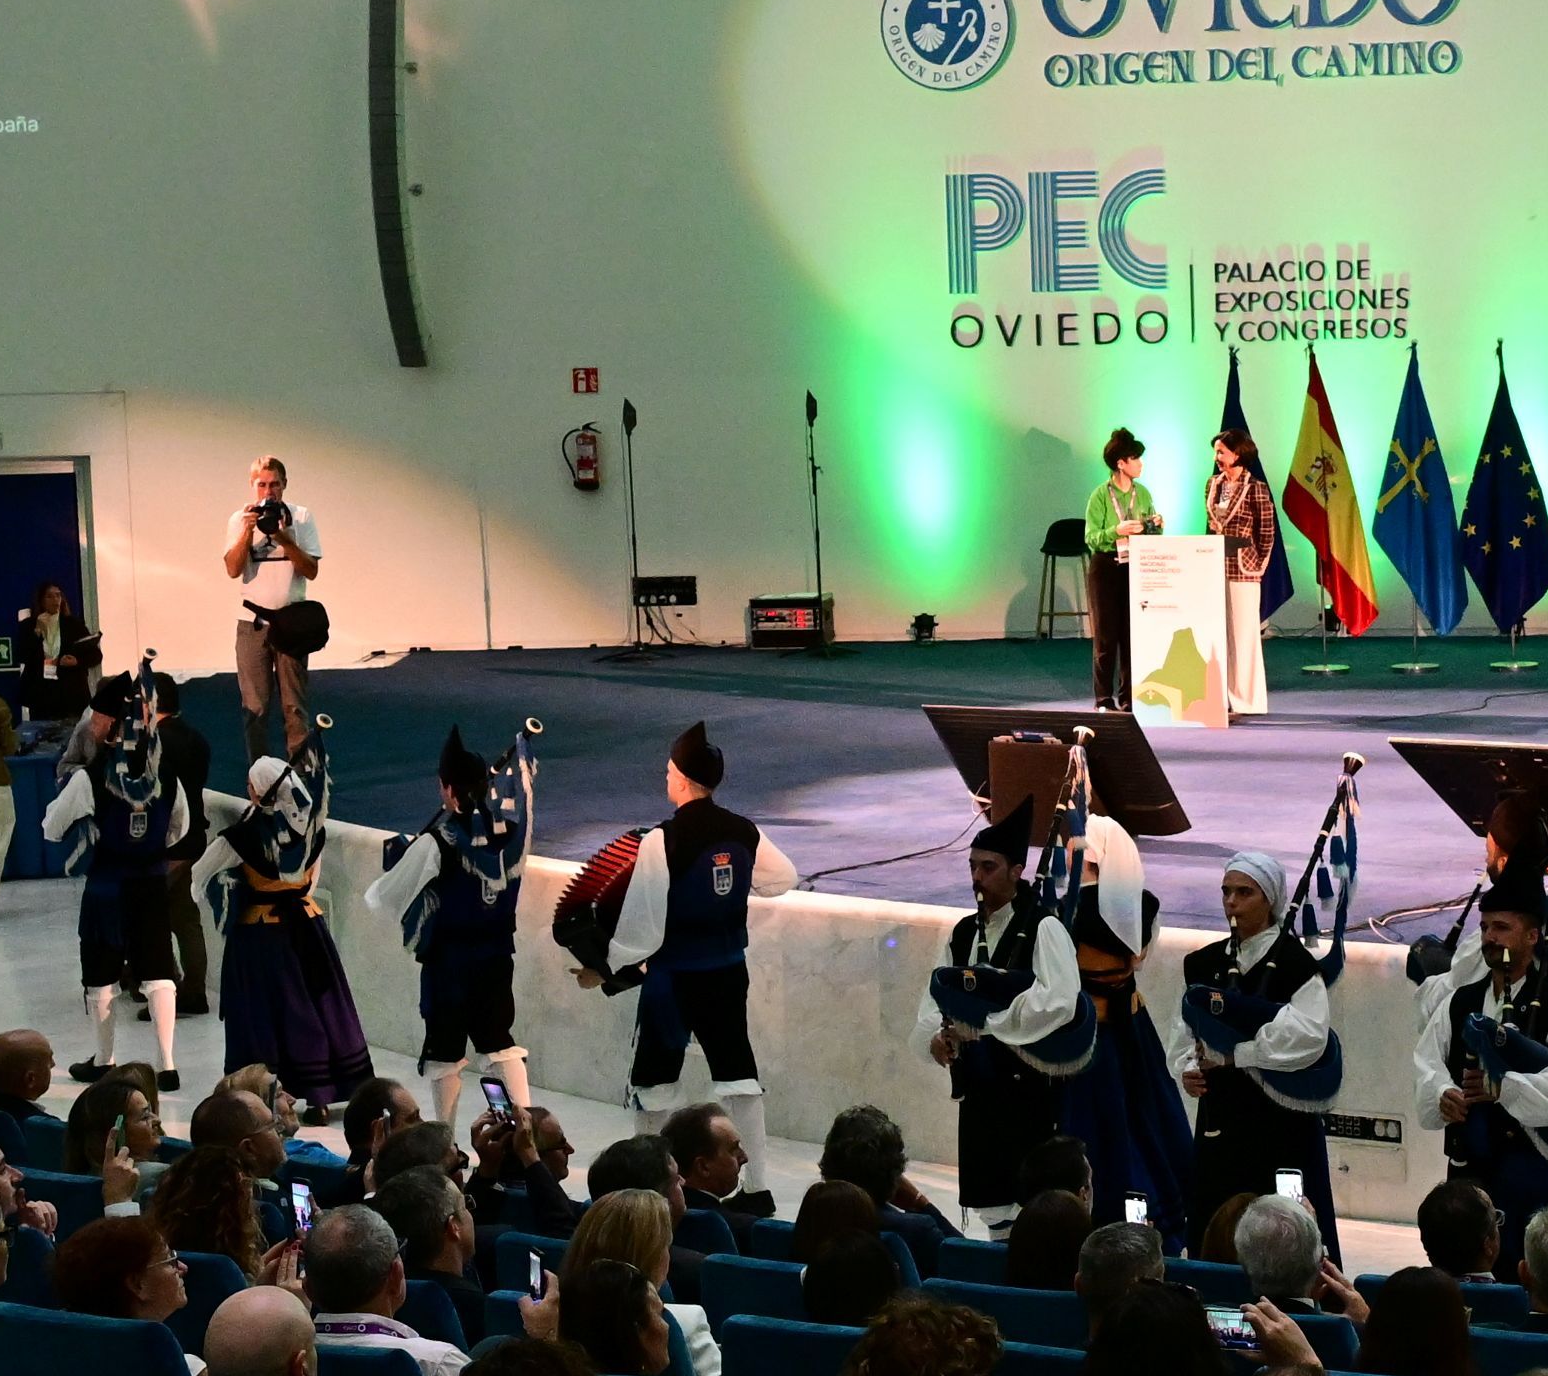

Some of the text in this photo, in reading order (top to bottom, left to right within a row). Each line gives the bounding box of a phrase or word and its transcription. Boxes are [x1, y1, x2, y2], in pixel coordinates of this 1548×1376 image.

[890, 22, 1002, 83] ORIGEN DEL CAMINO
[1043, 40, 1463, 88] ORIGEN DEL CAMINO
[945, 168, 1169, 294] PEC
[1214, 258, 1371, 284] PALACIO DE
[1215, 287, 1410, 313] EXPOSICIONES
[950, 310, 1169, 349] OVIEDO
[1215, 318, 1408, 343] Y CONGRESOS
